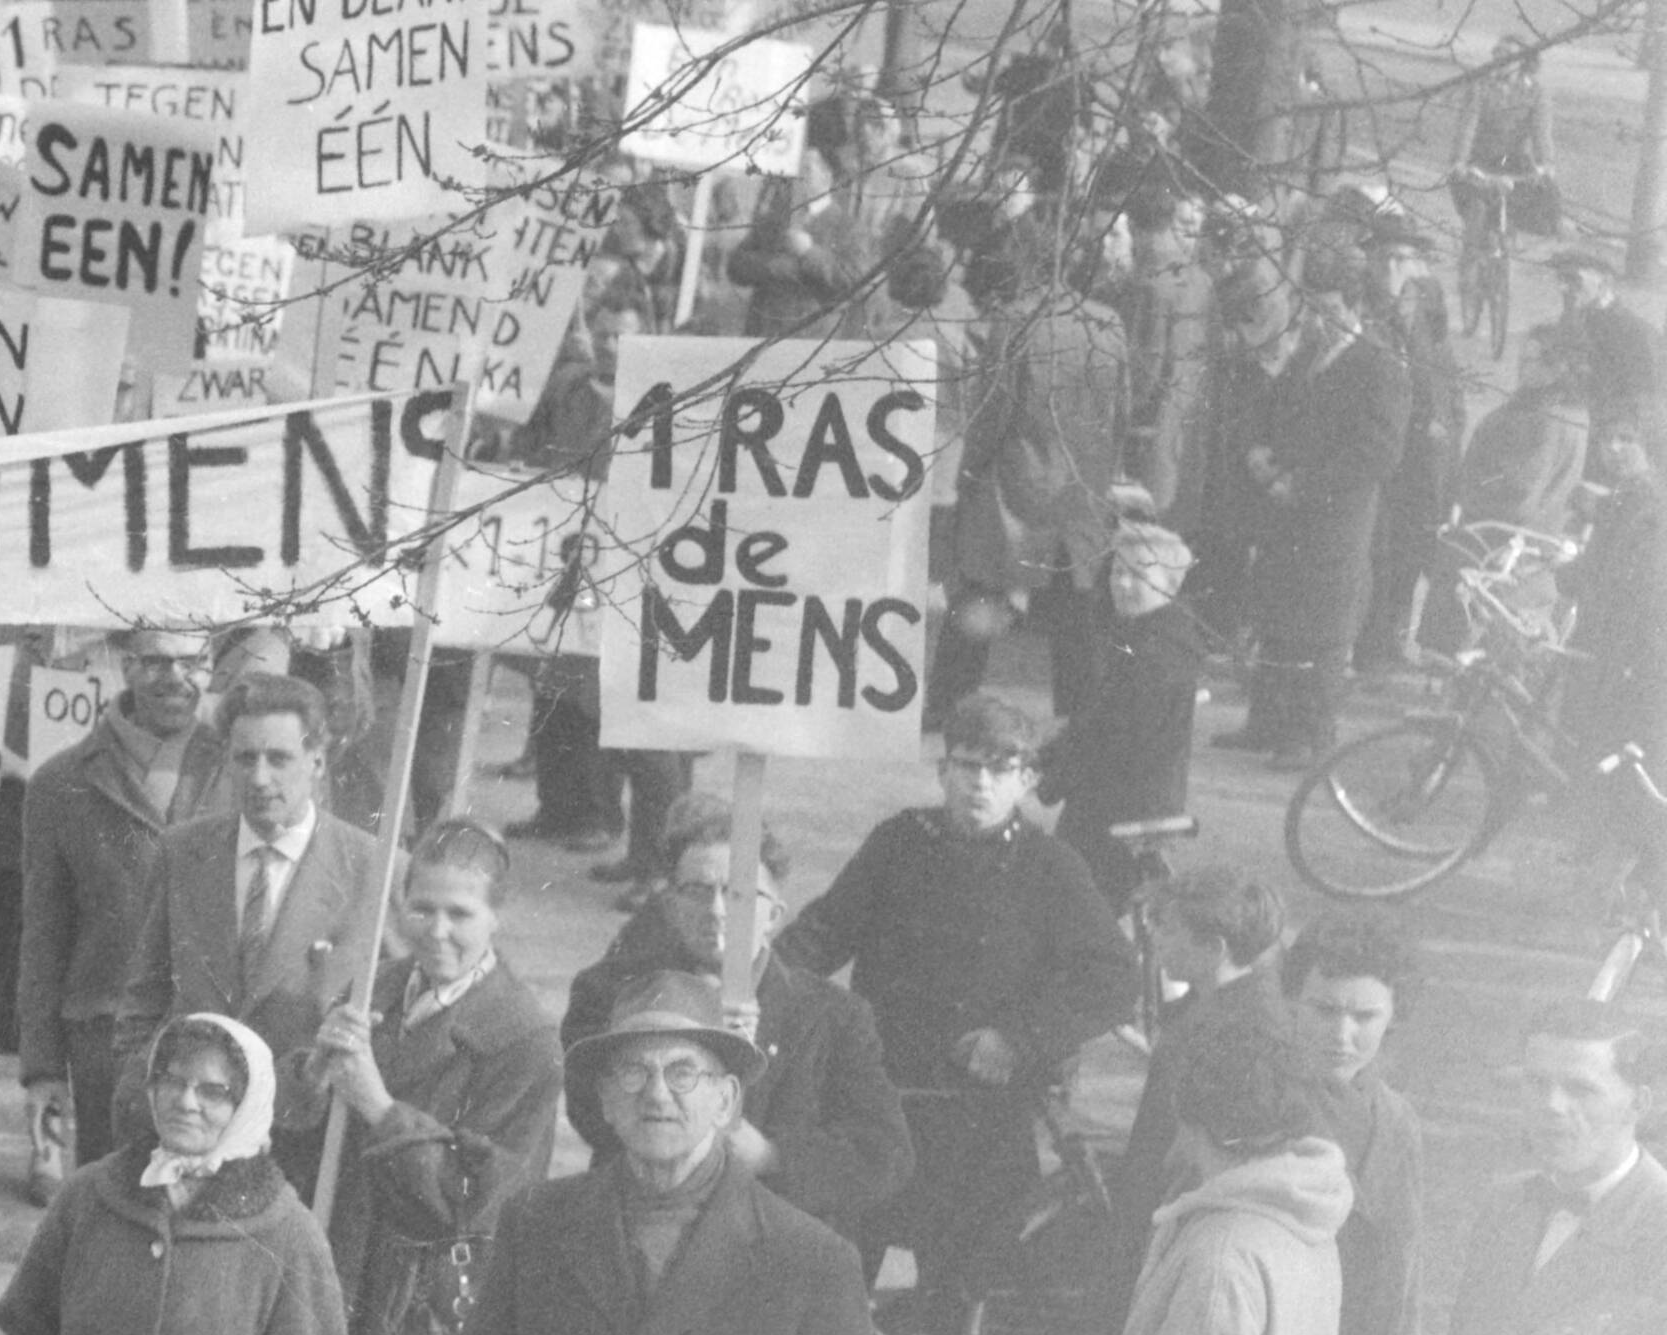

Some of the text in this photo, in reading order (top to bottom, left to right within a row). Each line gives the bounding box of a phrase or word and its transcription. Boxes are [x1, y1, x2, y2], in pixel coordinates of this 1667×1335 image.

[43, 16, 136, 54] RAS
[287, 19, 469, 105] SAMEN
[29, 121, 215, 215] SAMEN
[317, 100, 433, 195] ÉÉN
[38, 214, 196, 299] EEN!
[27, 390, 454, 574] MENS
[619, 382, 927, 502] 1 RAS
[659, 497, 789, 588] de
[637, 586, 923, 713] MENS
